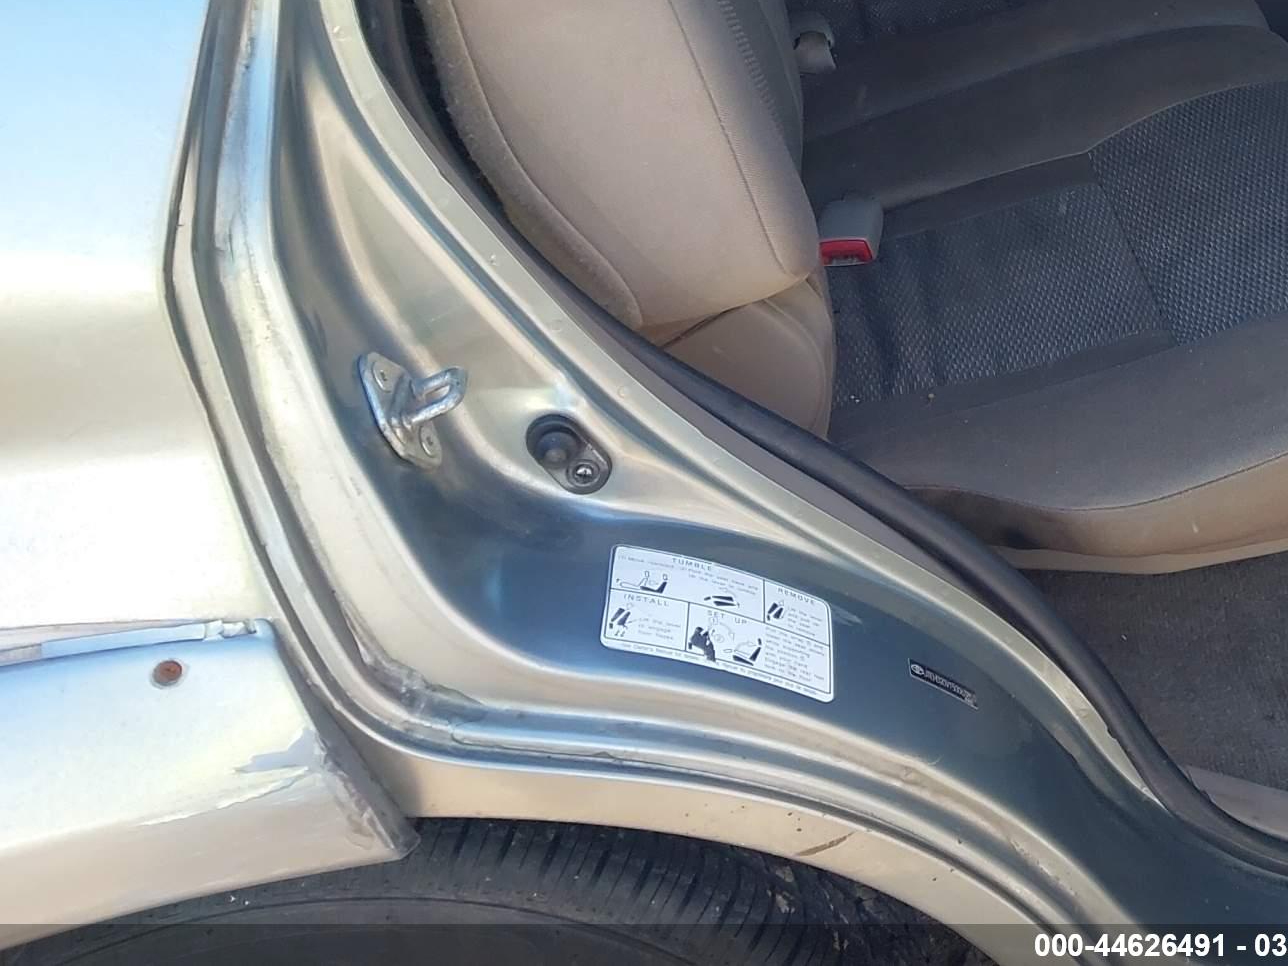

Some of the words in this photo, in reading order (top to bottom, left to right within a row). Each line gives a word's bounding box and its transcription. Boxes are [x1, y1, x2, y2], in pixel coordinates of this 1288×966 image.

[671, 557, 712, 572] TUMBLE
[623, 593, 670, 607] INSTALL
[777, 587, 815, 606] REMOVE
[707, 609, 726, 619] SET
[733, 616, 748, 625] UP
